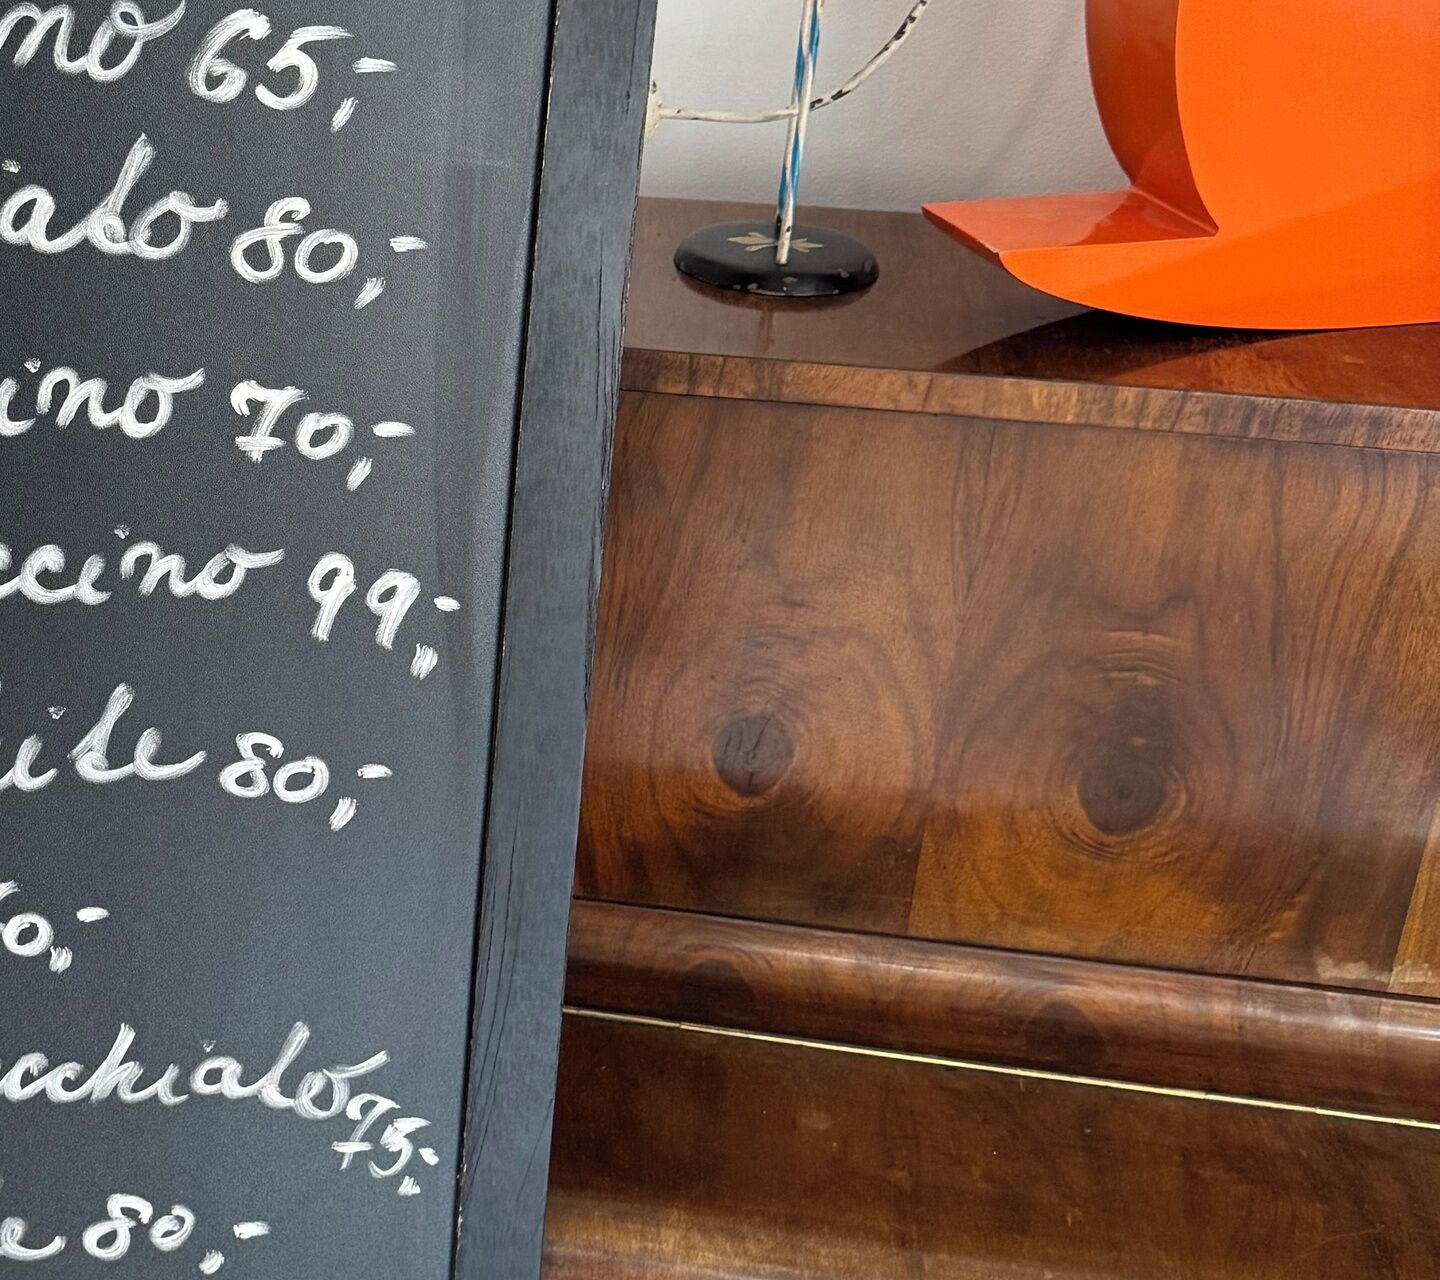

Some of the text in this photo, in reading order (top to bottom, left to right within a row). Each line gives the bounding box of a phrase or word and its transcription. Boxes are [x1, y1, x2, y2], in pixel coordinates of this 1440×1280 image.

[188, 9, 395, 130] 65,-
[230, 197, 426, 308] 80,-
[230, 380, 415, 490] 70,-
[307, 552, 460, 679] 99,-
[219, 732, 392, 830] 80,-
[82, 1194, 268, 1274] 80,-
